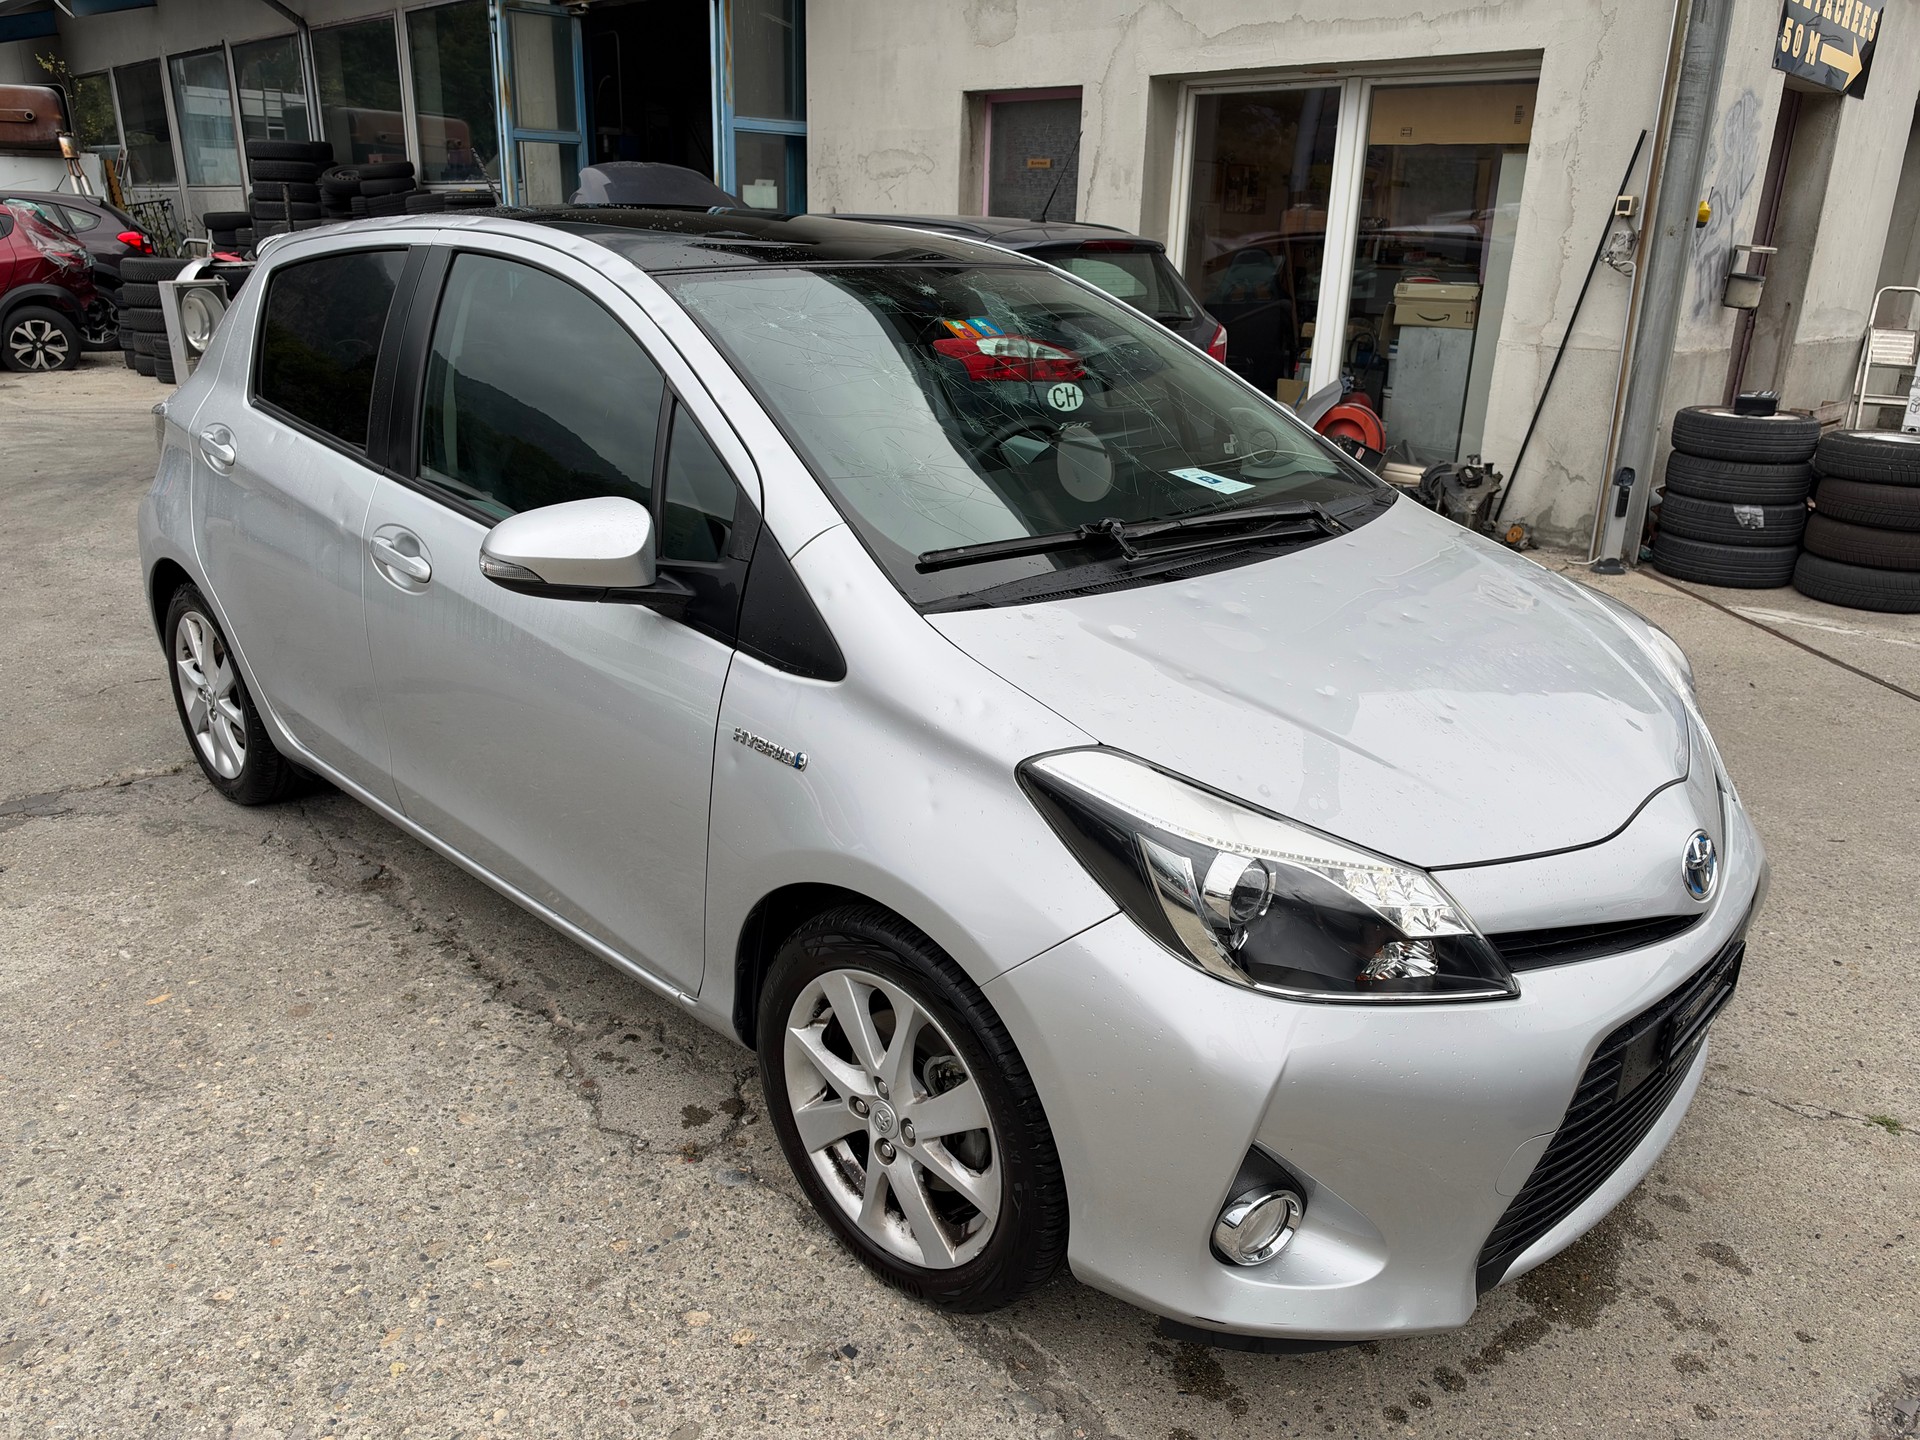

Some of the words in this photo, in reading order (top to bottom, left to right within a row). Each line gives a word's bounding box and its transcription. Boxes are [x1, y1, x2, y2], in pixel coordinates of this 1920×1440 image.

[1781, 17, 1804, 58] 50
[1805, 30, 1821, 66] M
[1791, 0, 1879, 42] ACHEES
[1053, 386, 1078, 408] CH
[733, 727, 796, 767] HYBRID
